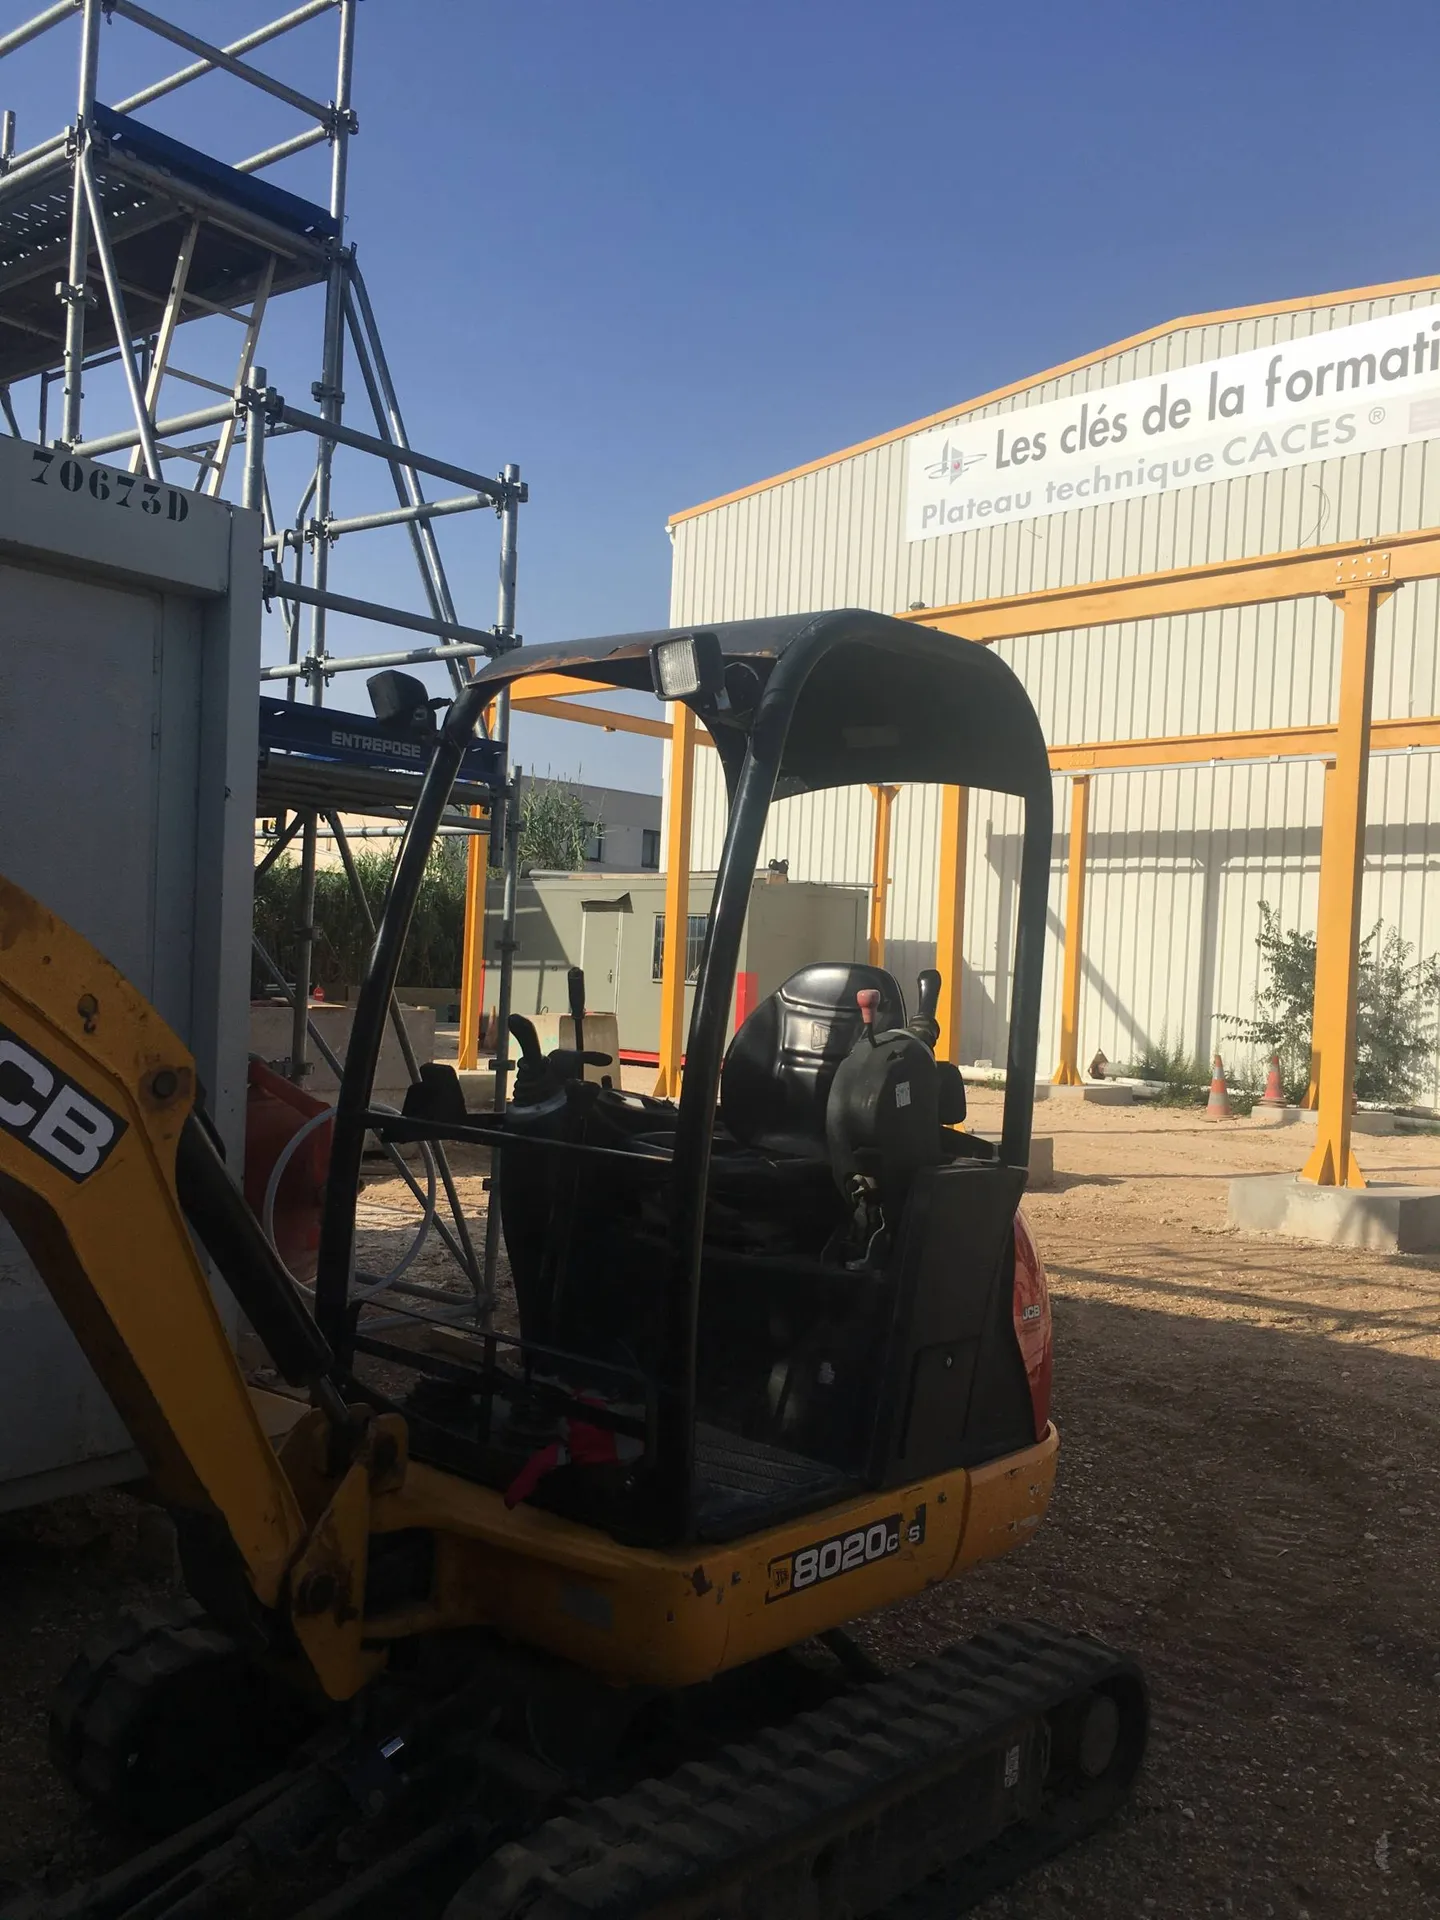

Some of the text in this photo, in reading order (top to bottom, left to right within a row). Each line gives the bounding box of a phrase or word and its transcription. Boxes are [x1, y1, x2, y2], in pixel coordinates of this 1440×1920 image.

[995, 320, 1440, 469] Les clés de la formati
[31, 450, 189, 522] 70673D
[922, 490, 1032, 529] Plateau
[1045, 452, 1214, 504] technique
[1222, 413, 1357, 466] CACES
[331, 731, 421, 759] ENTREPOSE
[1022, 1304, 1040, 1320] JCB
